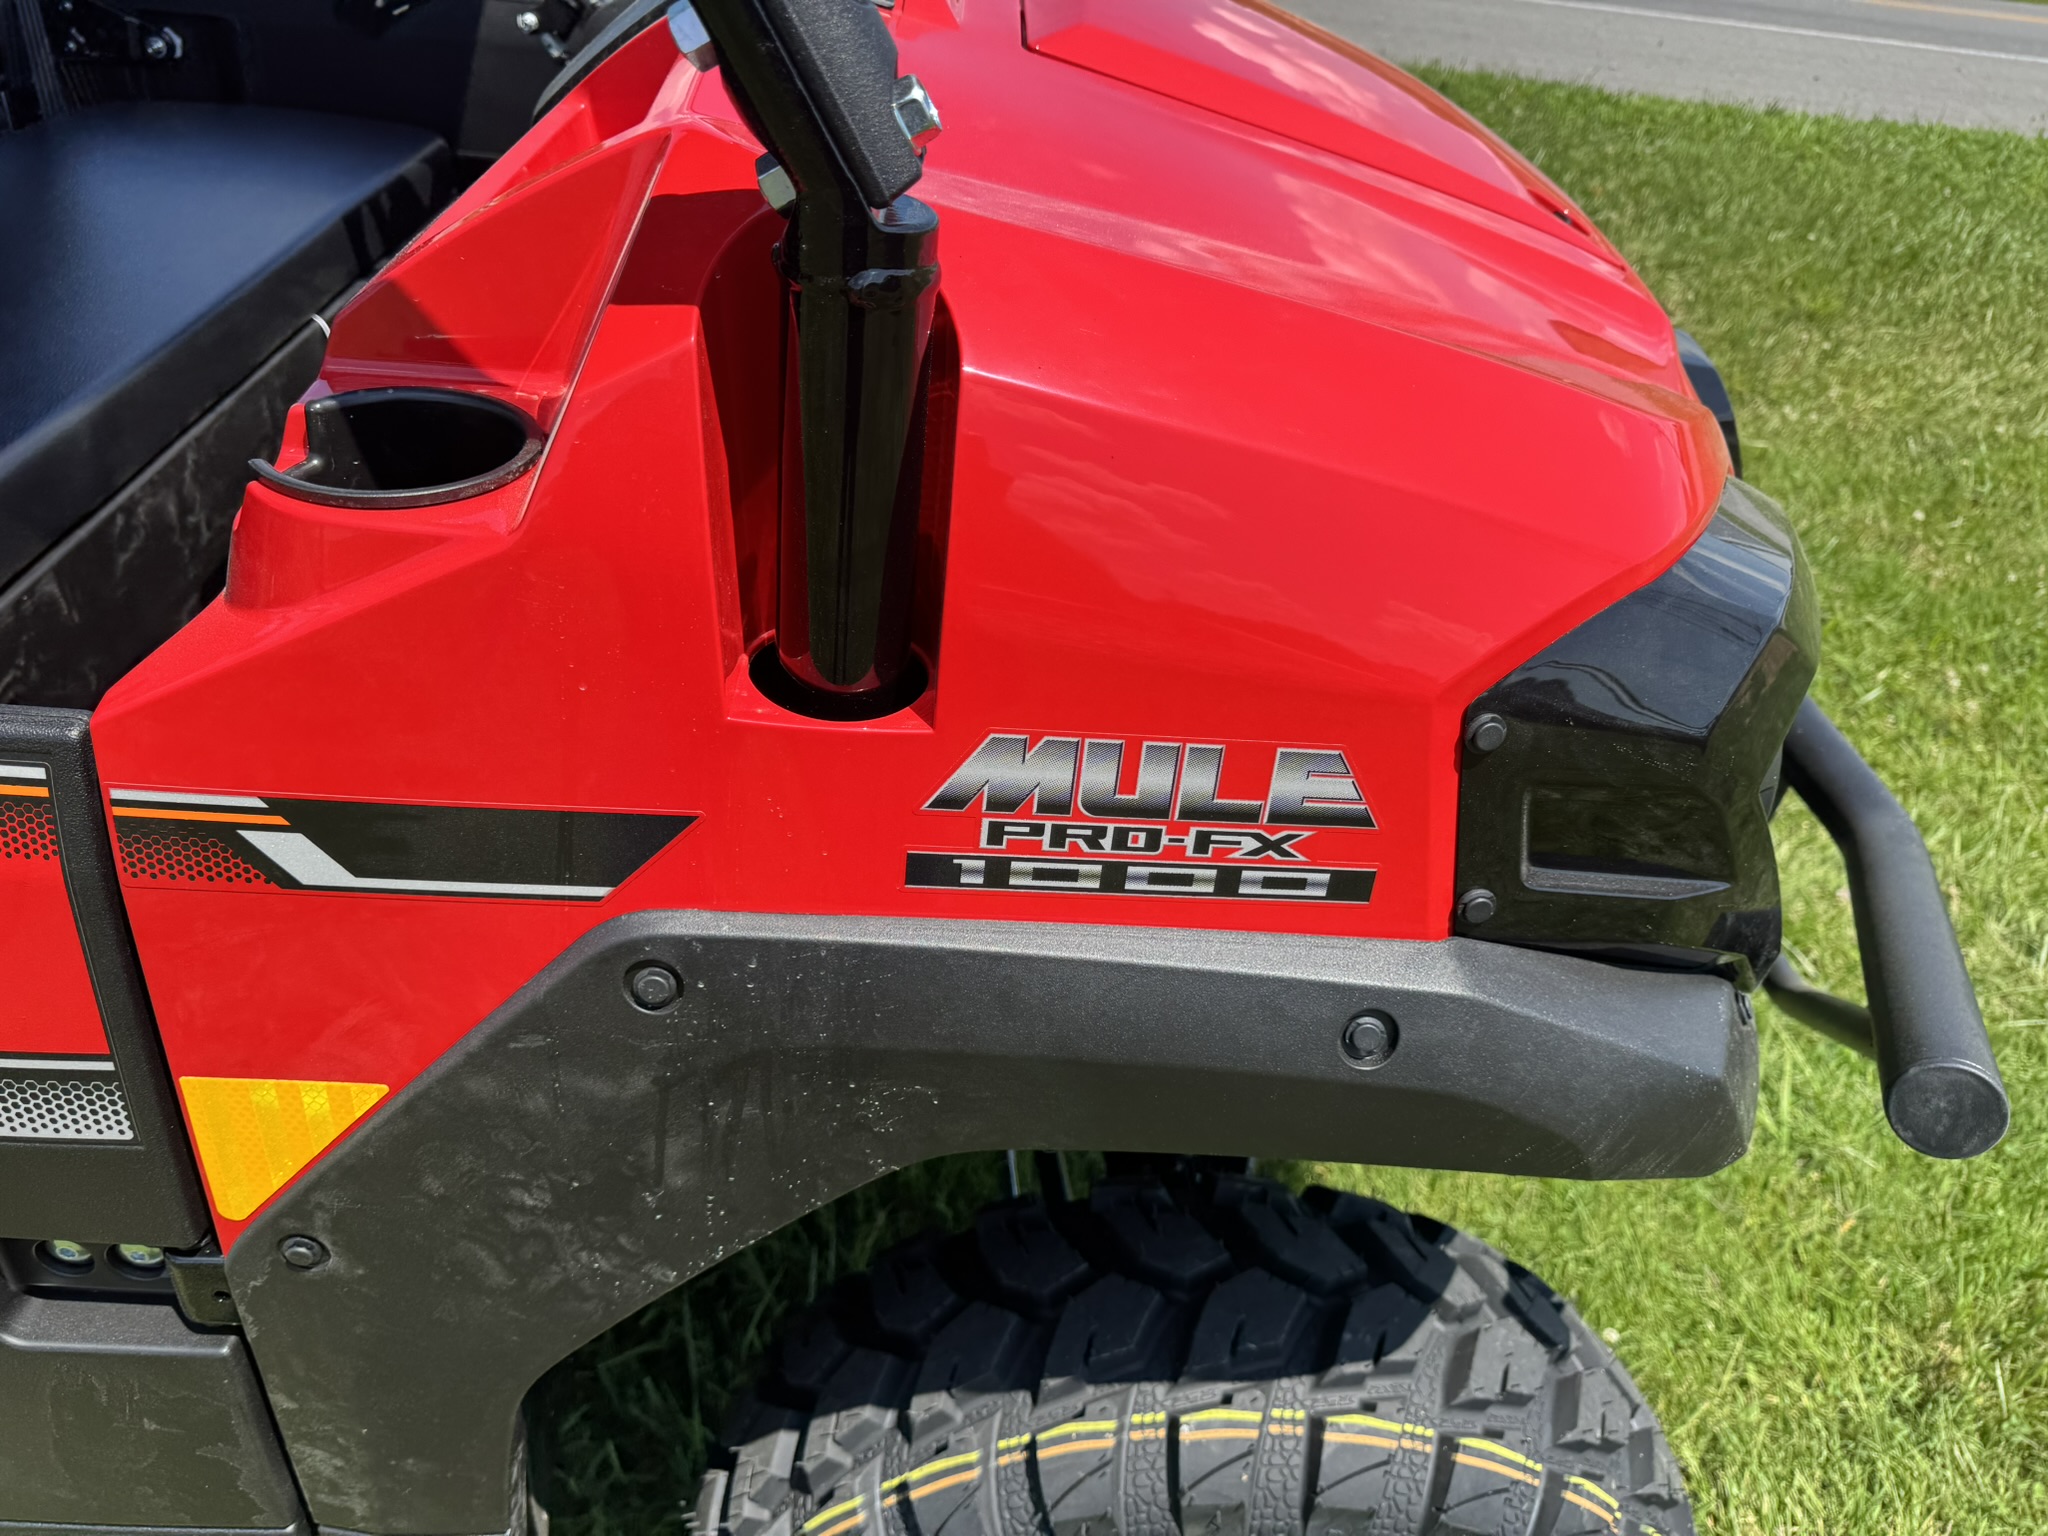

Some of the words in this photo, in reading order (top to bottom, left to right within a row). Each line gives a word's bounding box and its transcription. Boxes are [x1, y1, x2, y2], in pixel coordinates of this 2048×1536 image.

[921, 733, 1379, 829] MULE
[979, 817, 1317, 862] PRO-FX
[951, 858, 1332, 897] 1000
